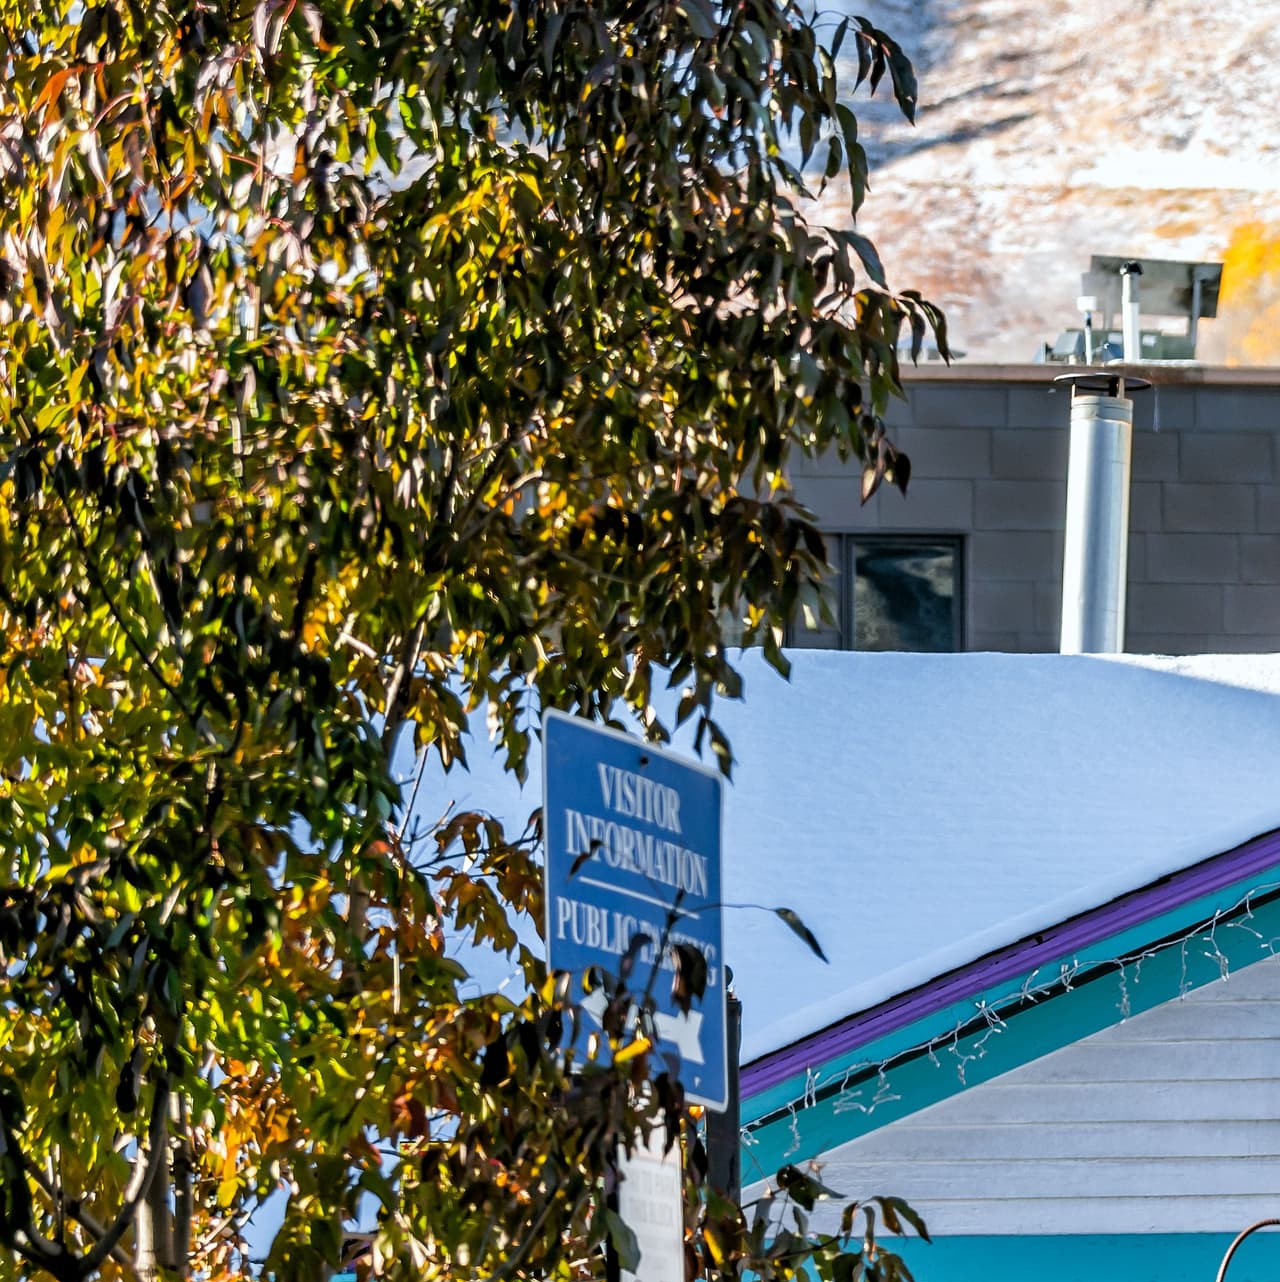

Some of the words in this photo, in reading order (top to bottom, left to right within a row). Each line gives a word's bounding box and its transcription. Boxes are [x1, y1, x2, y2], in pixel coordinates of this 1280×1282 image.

[598, 762, 682, 834] VISITOR
[565, 809, 709, 899] INFORMATION
[557, 896, 637, 955] PUBLIC
